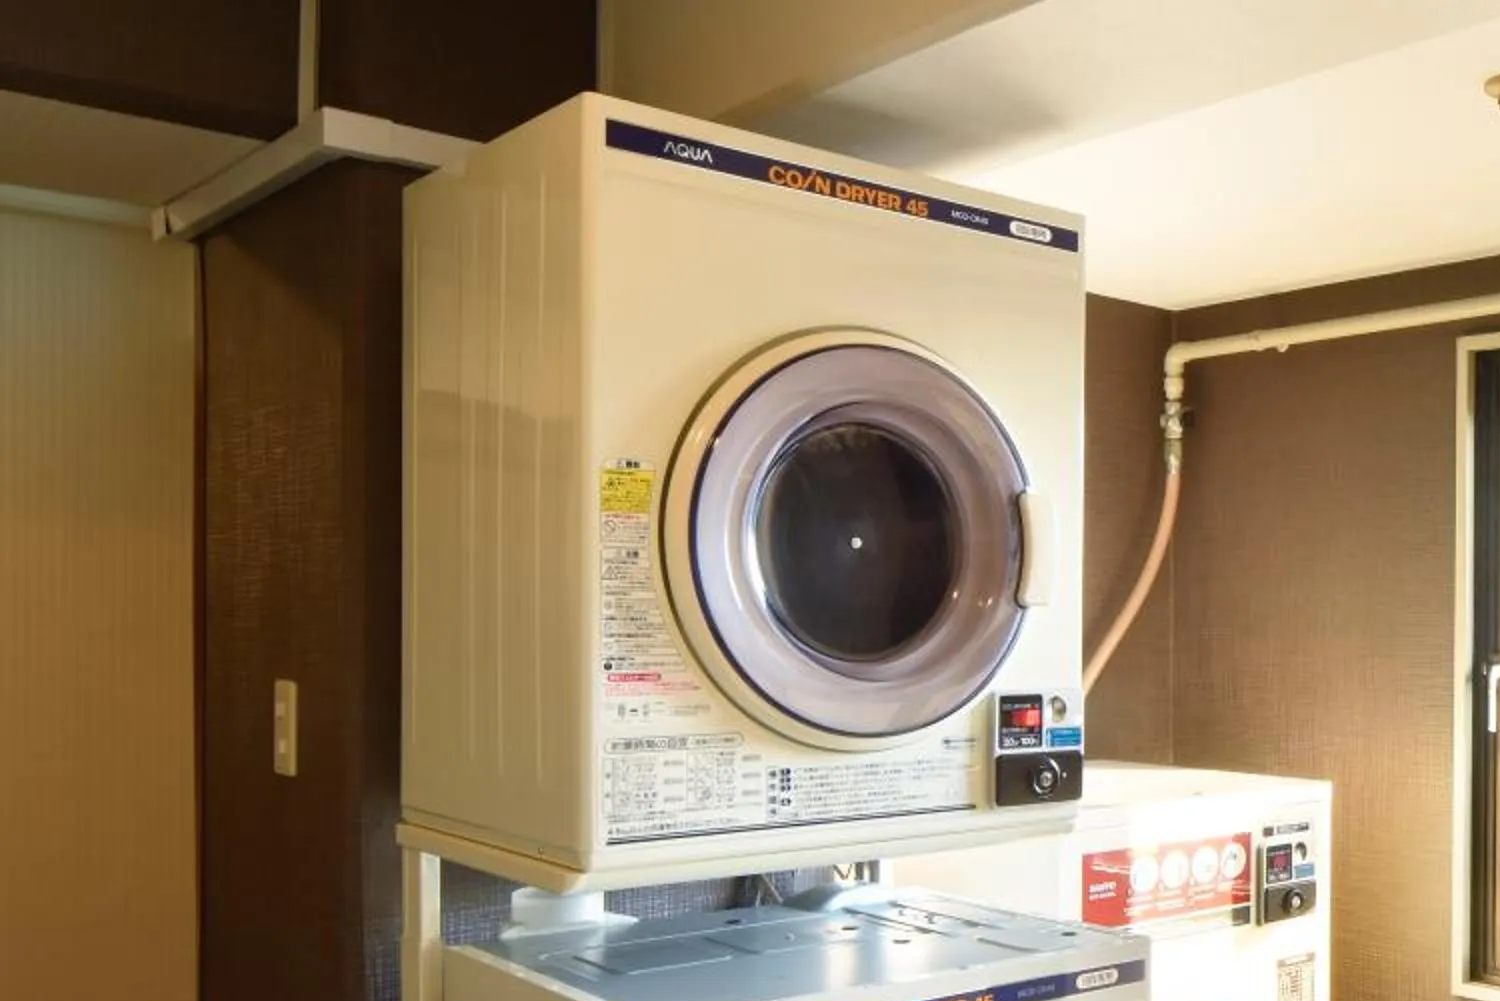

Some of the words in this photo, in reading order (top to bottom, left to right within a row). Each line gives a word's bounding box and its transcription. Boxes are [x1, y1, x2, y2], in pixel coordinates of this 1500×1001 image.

[663, 140, 713, 164] AQUA
[836, 180, 901, 210] DRYER
[906, 199, 929, 217] 45
